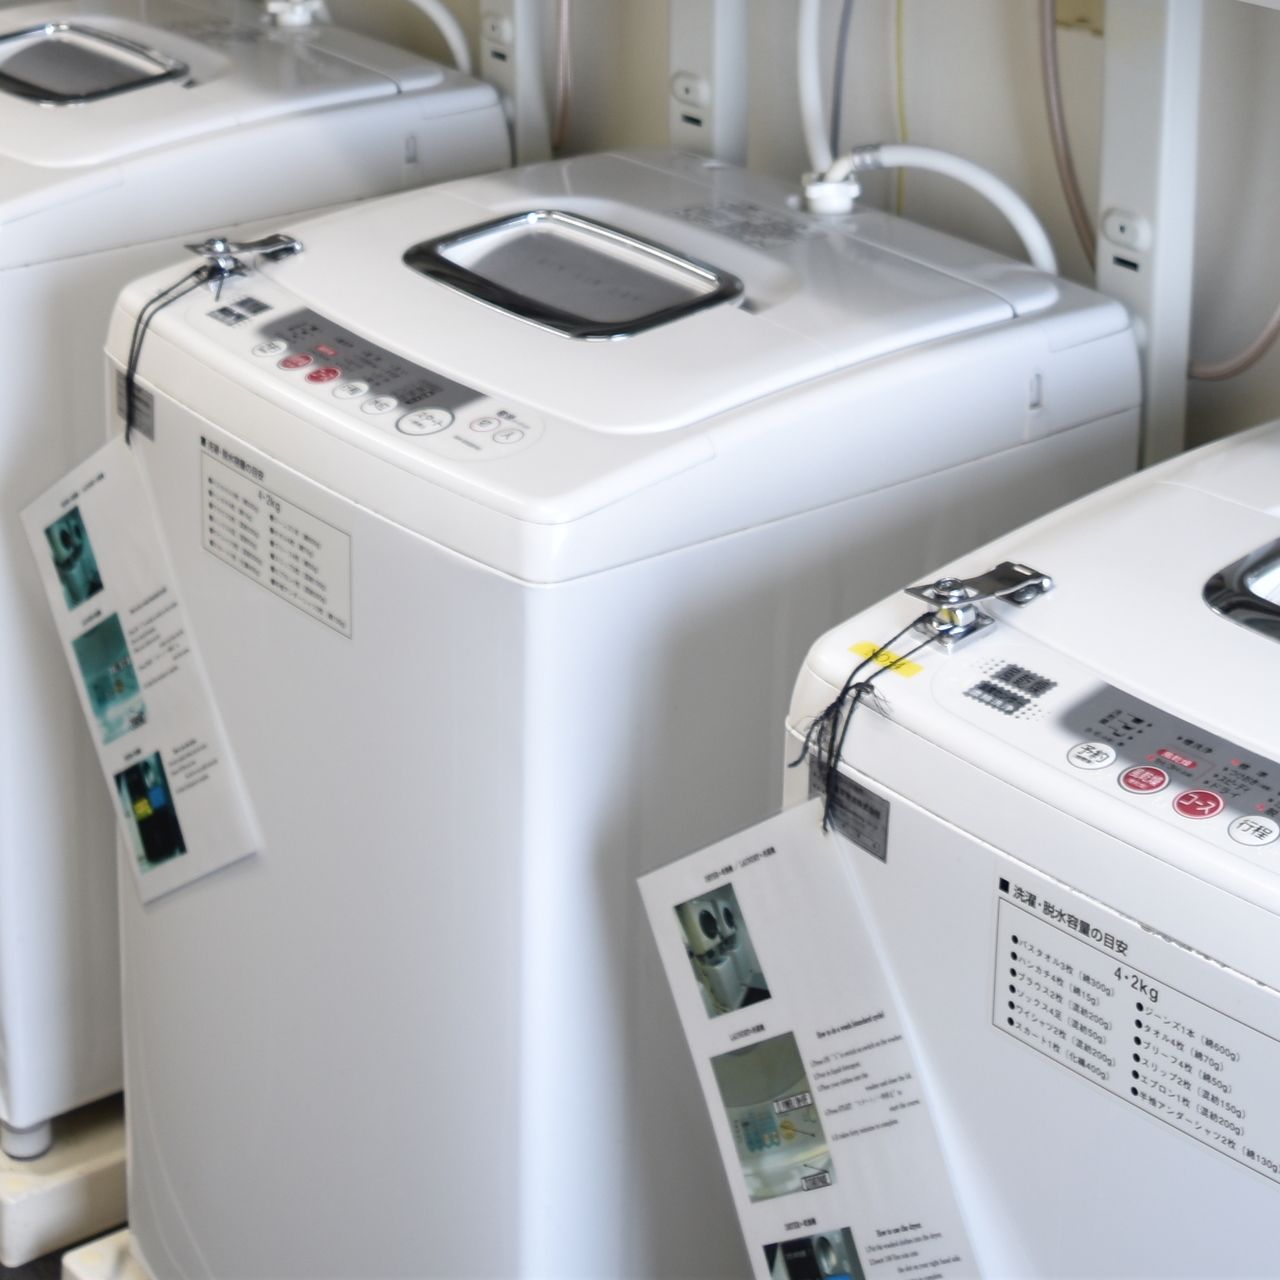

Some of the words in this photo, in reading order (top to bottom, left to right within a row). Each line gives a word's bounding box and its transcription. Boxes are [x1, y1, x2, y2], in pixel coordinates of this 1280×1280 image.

[1077, 744, 1110, 762] 予約
[1179, 792, 1217, 815] コース
[1237, 820, 1273, 840] 行程
[1013, 884, 1129, 958] 洗濯・脱水容量の目安
